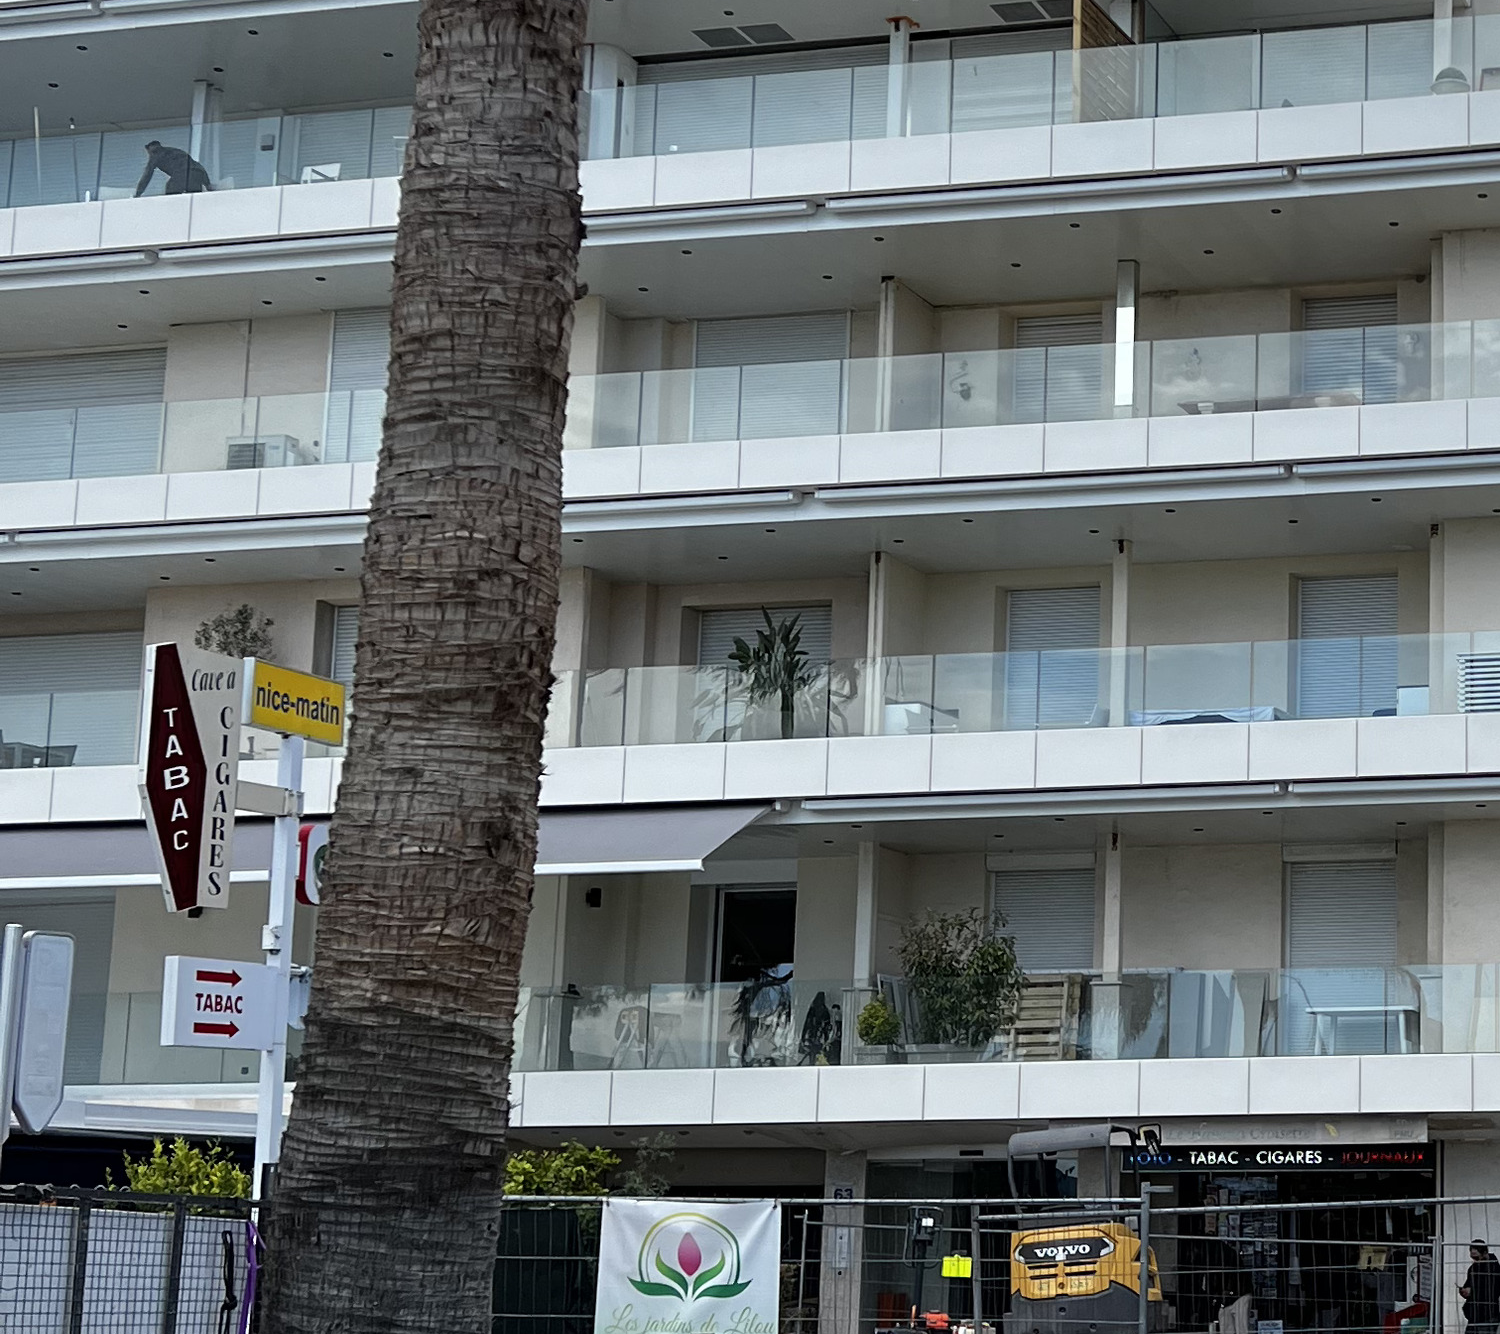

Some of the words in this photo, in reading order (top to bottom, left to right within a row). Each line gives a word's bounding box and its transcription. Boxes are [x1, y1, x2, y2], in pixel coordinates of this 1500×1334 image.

[256, 681, 340, 726] nice-matin
[163, 707, 190, 851] TABAC
[208, 706, 234, 896] CIGARES
[195, 993, 243, 1014] TABAC
[1189, 1151, 1239, 1165] TABAC
[1256, 1151, 1322, 1165] CIGARES
[1034, 1244, 1091, 1258] VOLVO
